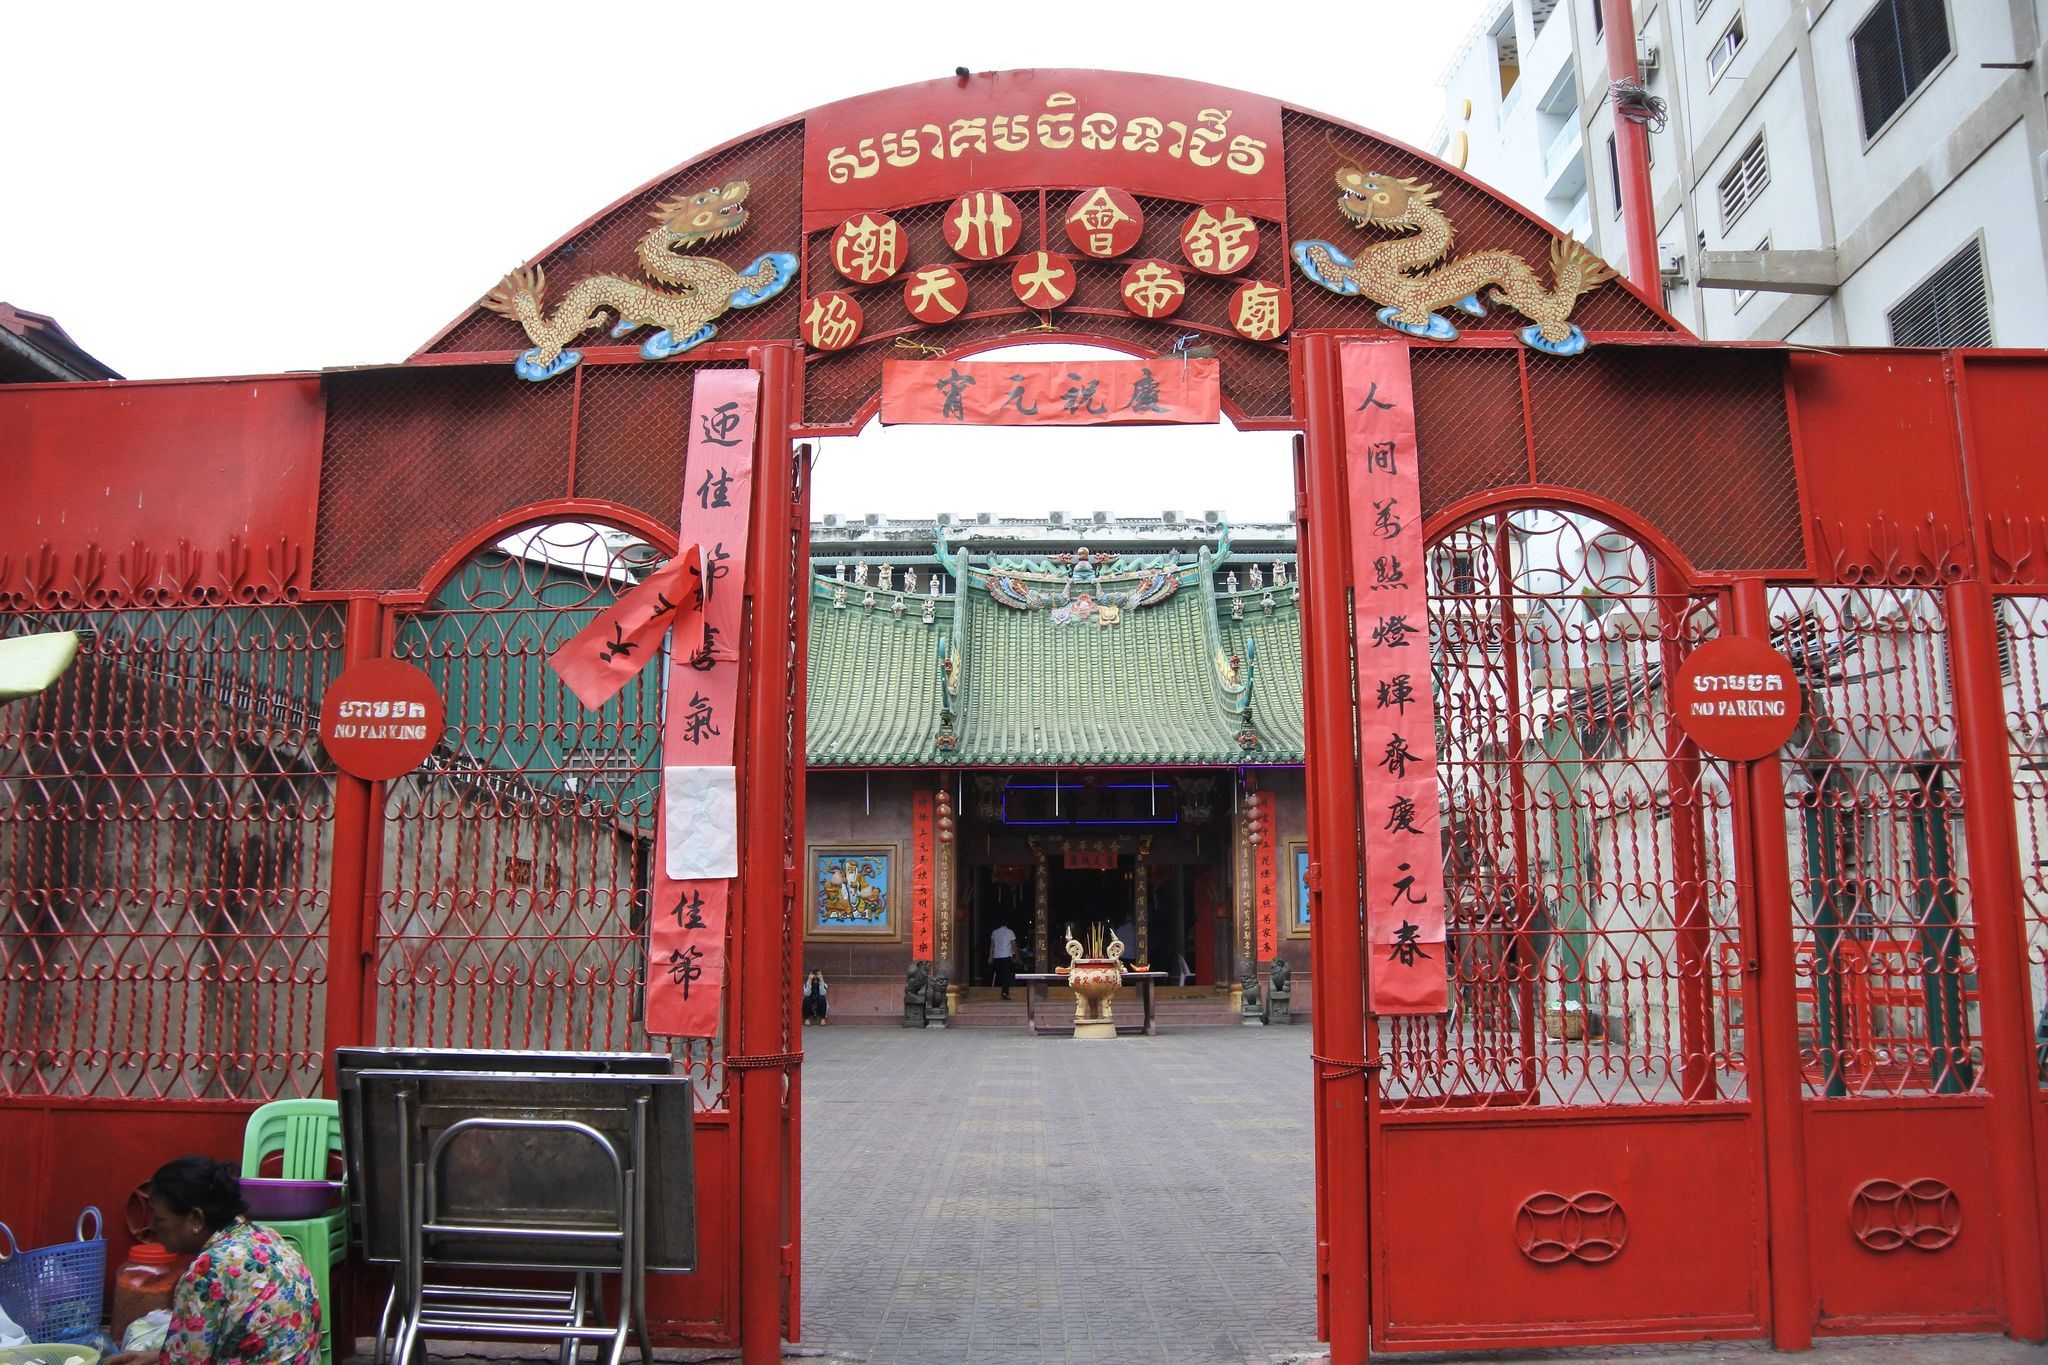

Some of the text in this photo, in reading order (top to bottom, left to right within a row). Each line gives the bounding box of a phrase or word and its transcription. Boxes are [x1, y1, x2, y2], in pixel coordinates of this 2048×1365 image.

[1690, 700, 1785, 717] NO PARKING
[334, 724, 427, 740] NO PARKING
